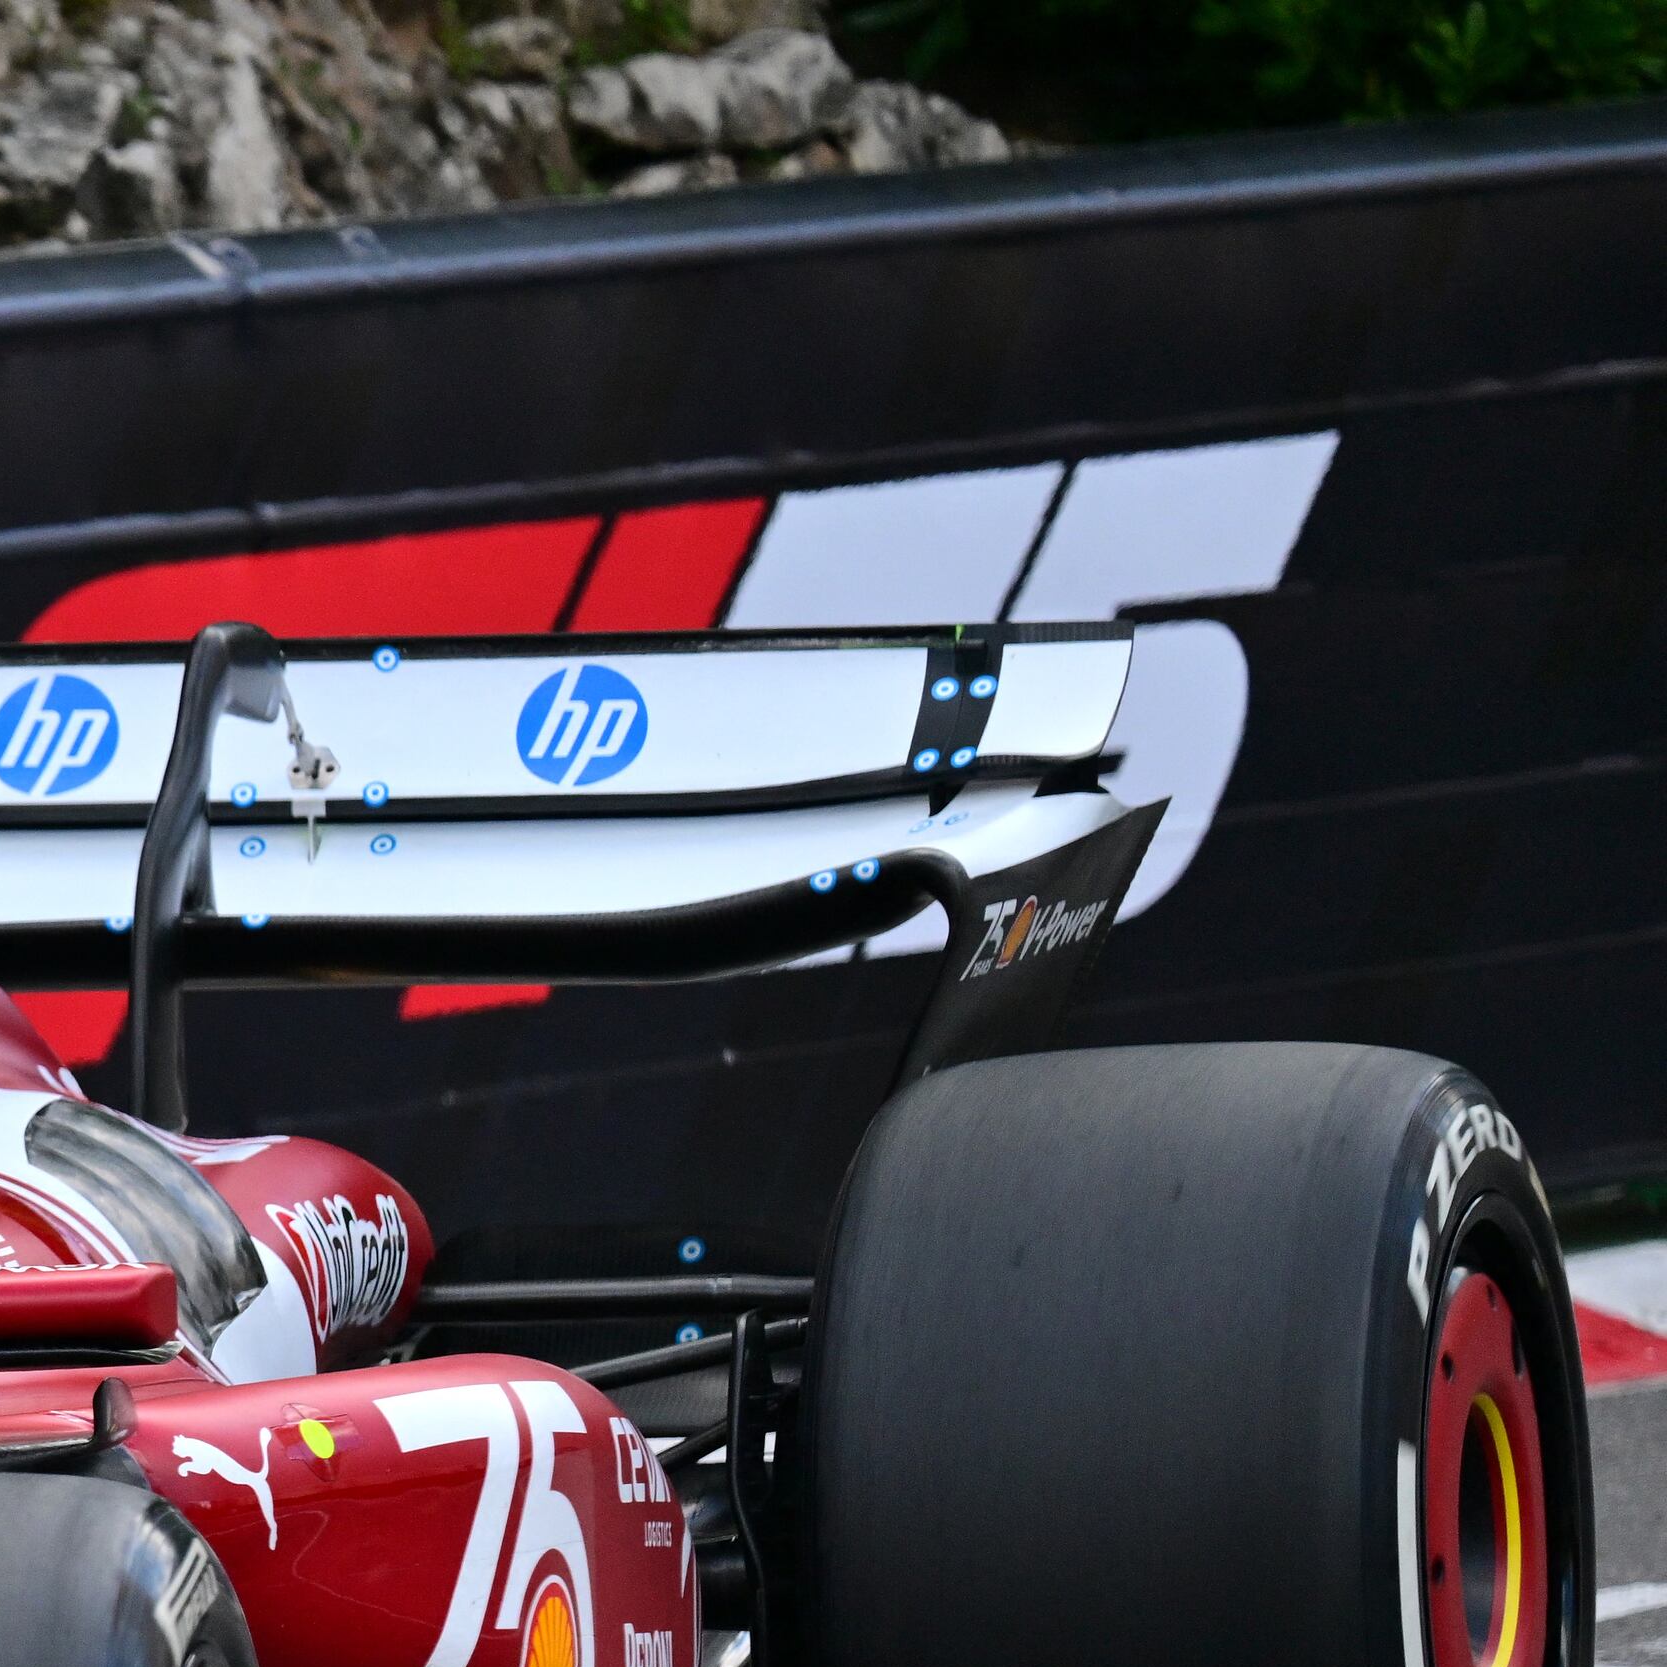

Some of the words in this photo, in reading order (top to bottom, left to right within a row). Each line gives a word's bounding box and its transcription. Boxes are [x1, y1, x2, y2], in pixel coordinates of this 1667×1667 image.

[0, 674, 110, 797] hp
[529, 665, 637, 786] hp
[1425, 1103, 1522, 1235] ZERO
